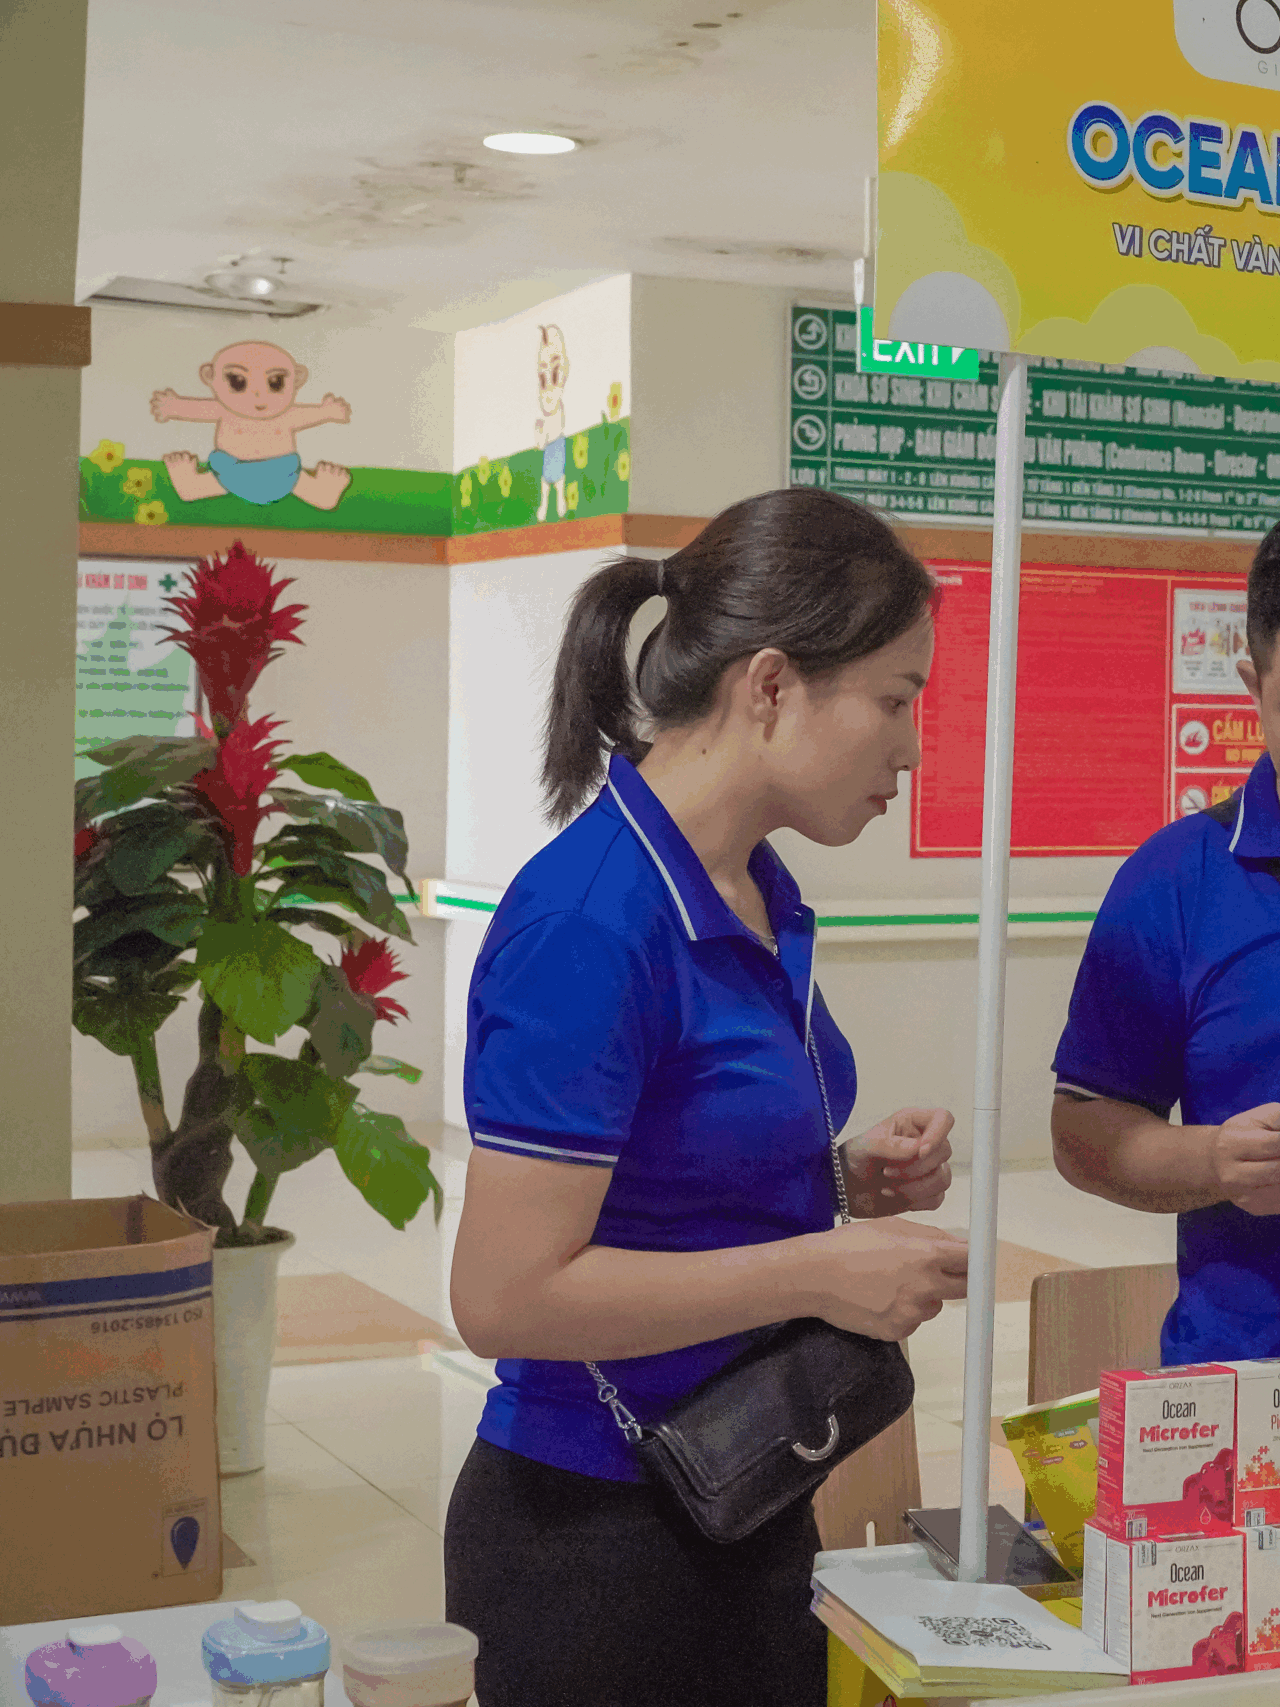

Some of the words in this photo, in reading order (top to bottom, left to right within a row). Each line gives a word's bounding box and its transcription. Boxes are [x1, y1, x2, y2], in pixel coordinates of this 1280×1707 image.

[1113, 223, 1141, 257] VI
[1150, 225, 1226, 269] CHẤT
[3, 1392, 91, 1417] SAMPLE
[99, 1382, 183, 1408] PLASTIC
[1163, 1400, 1196, 1419] Ocean
[49, 1420, 137, 1452] NHỰA
[147, 1412, 183, 1441] LỌ
[1139, 1422, 1219, 1443] Microfer
[1170, 1563, 1204, 1583] Ocean
[1147, 1585, 1228, 1608] Microfer
